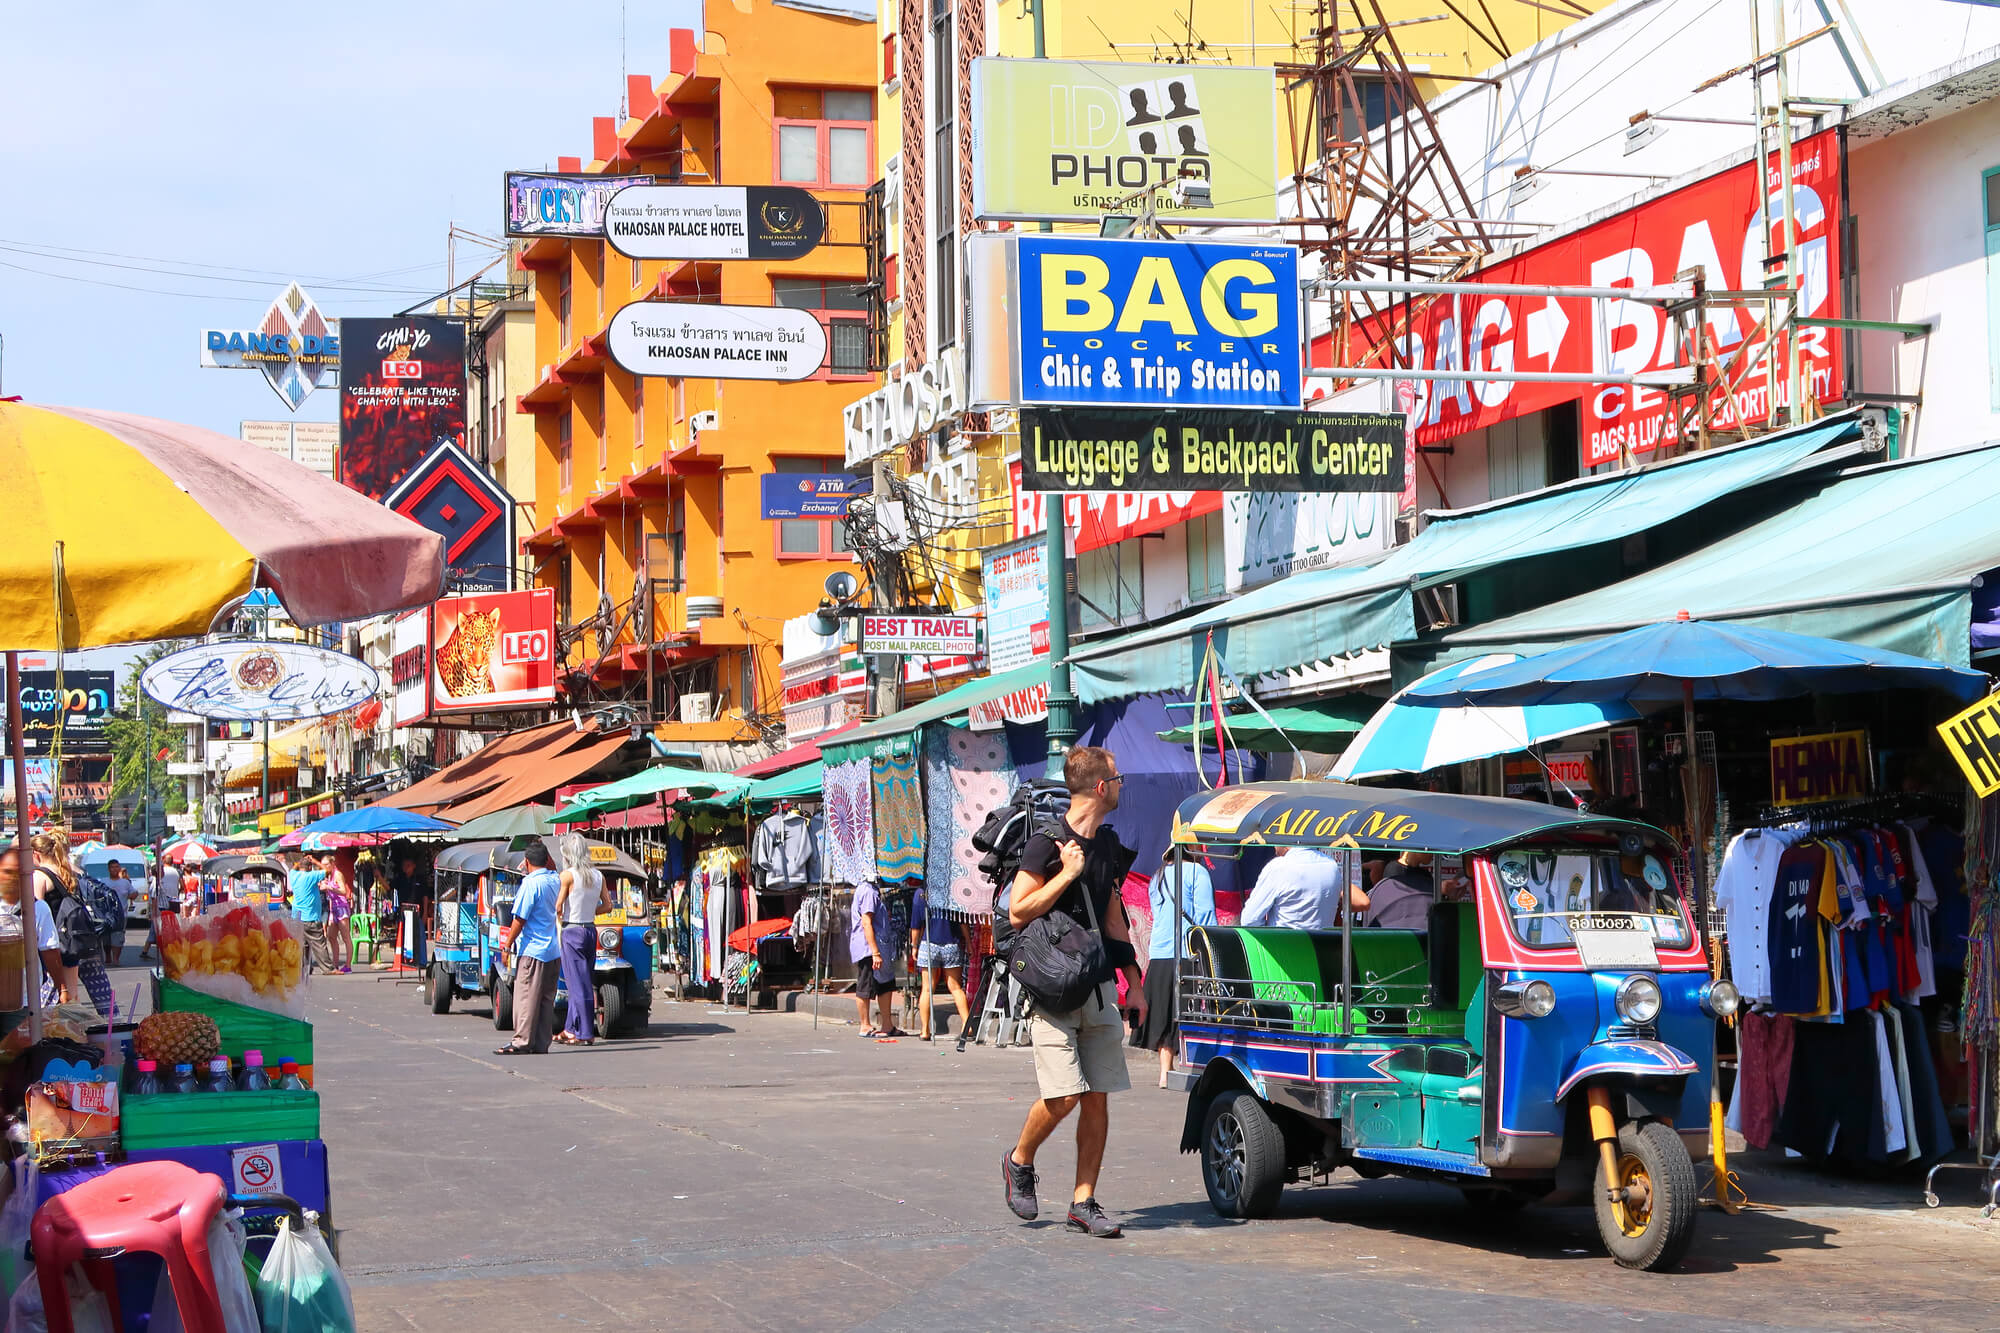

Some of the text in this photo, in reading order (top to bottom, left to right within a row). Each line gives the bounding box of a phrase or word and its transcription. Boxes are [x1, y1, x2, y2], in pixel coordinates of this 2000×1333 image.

[1050, 85, 1121, 149] ID
[510, 187, 583, 223] LUCKY
[610, 204, 642, 217] โรงแรม
[645, 203, 680, 217] ข้าวสาร
[614, 222, 744, 237] KHAOSAN PALACE HOTEL
[1040, 253, 1279, 338] BAG
[207, 331, 288, 354] DANG
[376, 327, 431, 352] CHAI-YO
[631, 321, 675, 338] โรงแรม
[681, 323, 728, 340] ข้าวสาร
[778, 328, 805, 344] อินน์
[242, 353, 290, 362] Authentic
[296, 355, 316, 363] Thai
[649, 346, 788, 362] KHAOSAN PALACE INN
[384, 363, 420, 377] LEO
[1041, 353, 1280, 398] Chic & Trip Station
[403, 397, 424, 406] WITH
[408, 387, 427, 396] LIKE
[1034, 426, 1393, 488] Luggage & Backpack Center
[817, 482, 844, 492] ATM
[993, 545, 1040, 576] BEST TRAVEL
[1272, 552, 1330, 578] EAK TATTOO GROUP
[864, 617, 974, 638] BEST TRAVEL
[505, 632, 547, 661] LEO
[864, 641, 975, 652] POST MAIL PARCEL PHOTO
[168, 658, 356, 700] The Club
[1772, 737, 1862, 800] HENNA
[1264, 808, 1418, 841] All of Me
